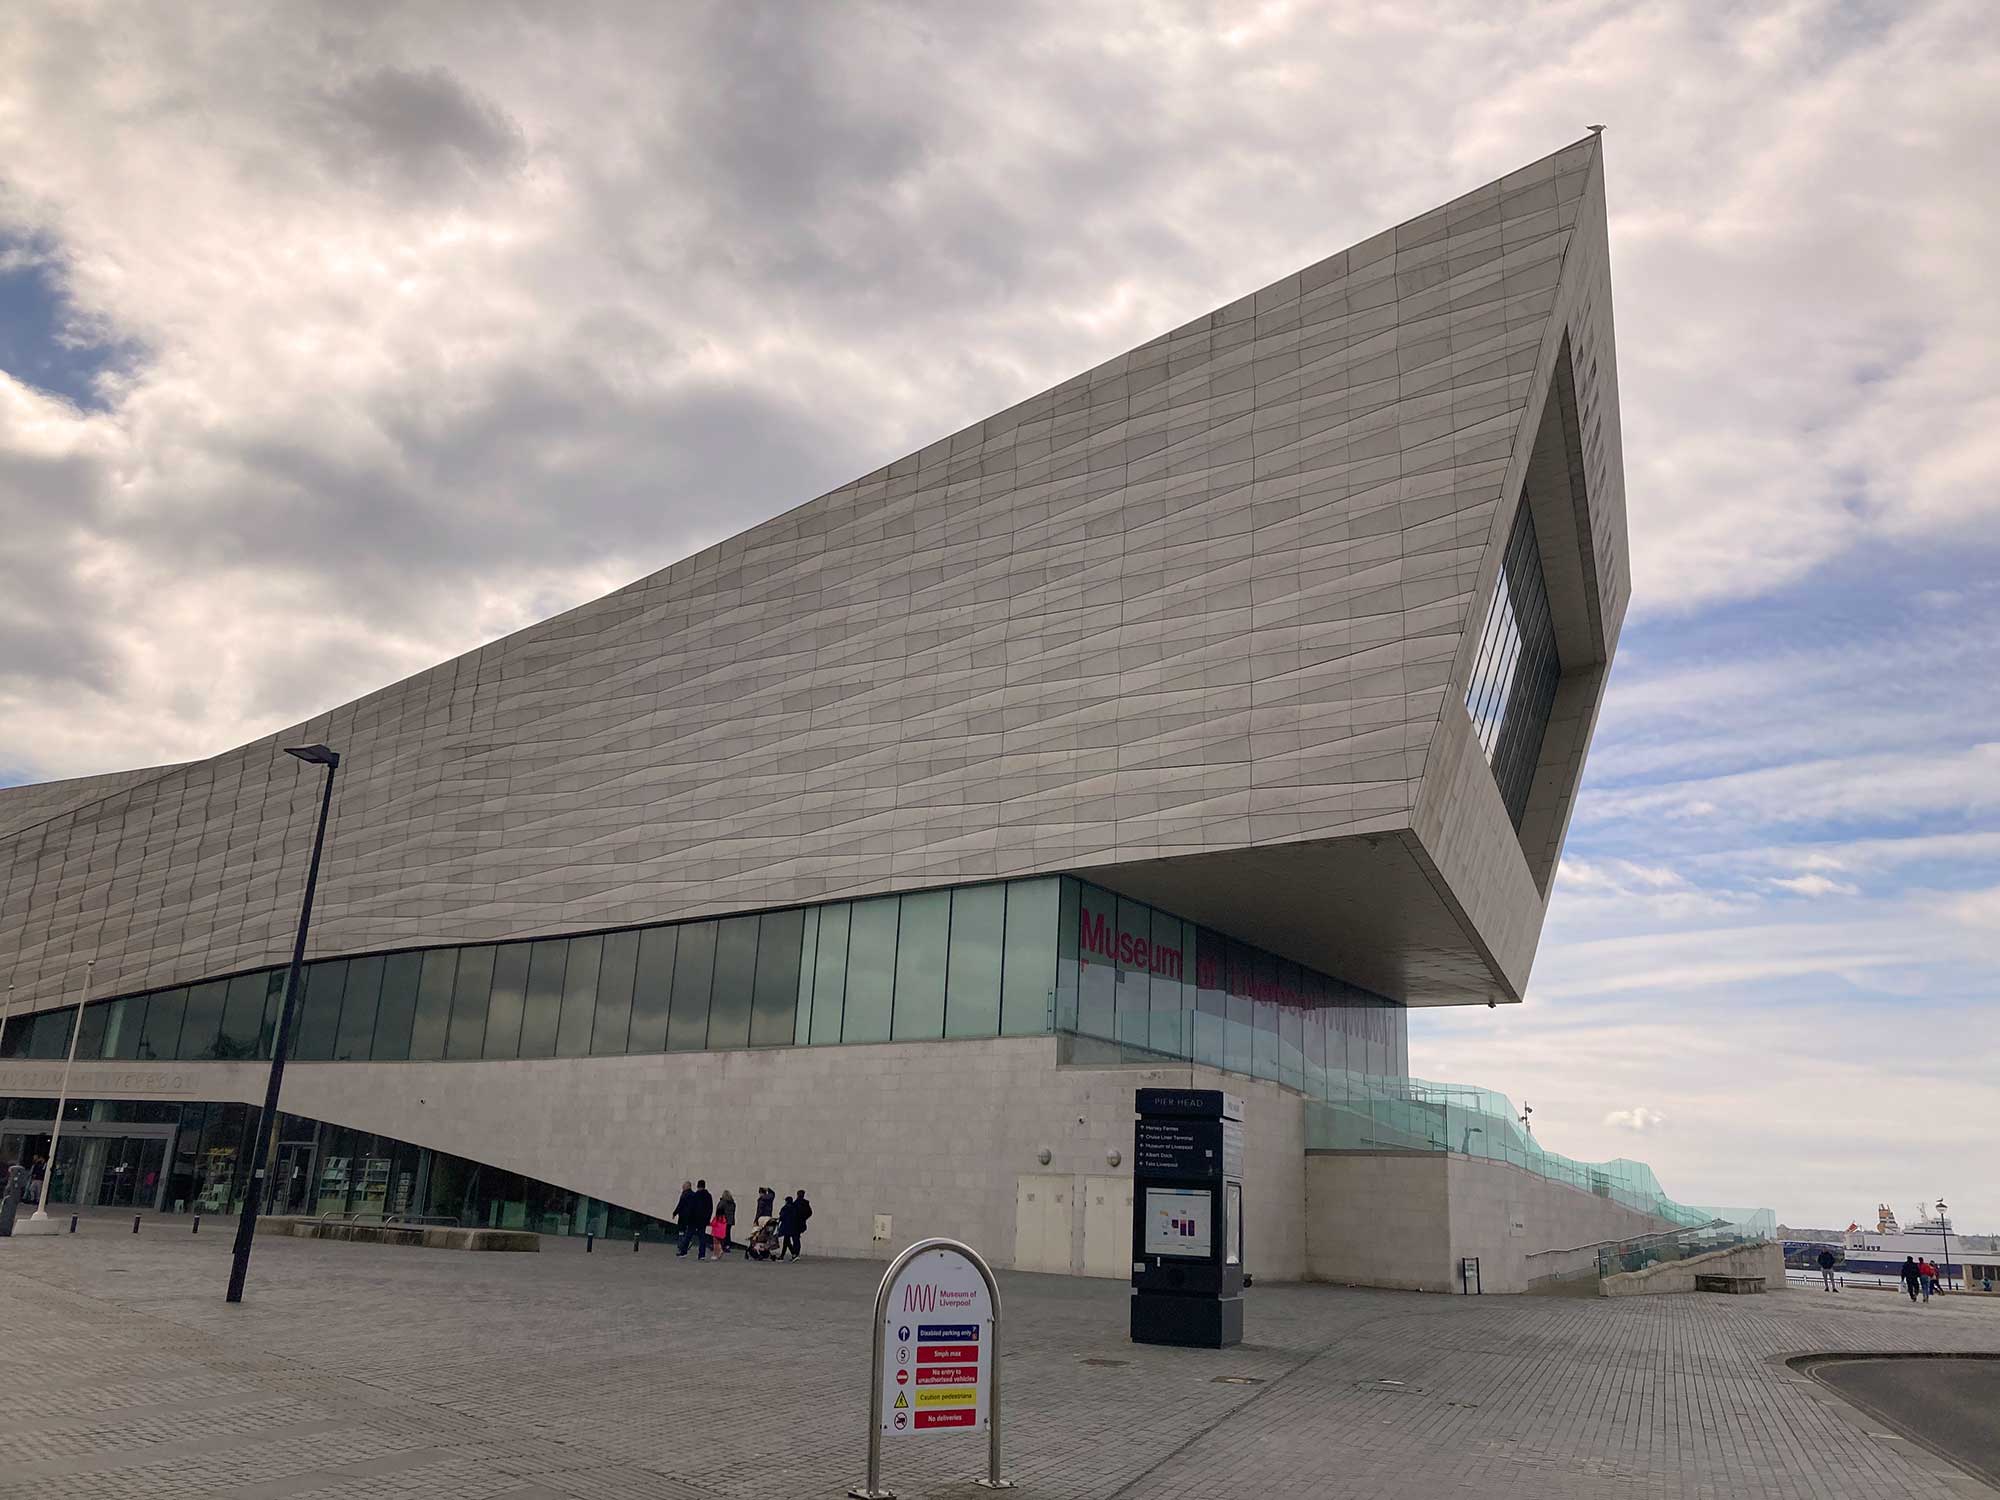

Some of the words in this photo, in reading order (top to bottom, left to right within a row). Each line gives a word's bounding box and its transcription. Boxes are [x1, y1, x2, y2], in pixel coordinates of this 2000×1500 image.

[1081, 908, 1183, 979] Museum
[1154, 1097, 1174, 1105] PIER
[1177, 1098, 1203, 1108] HEAD
[940, 1290, 969, 1298] Museum
[969, 1290, 977, 1298] of
[939, 1299, 971, 1308] Liverpool
[920, 1329, 942, 1337] Disabled
[942, 1329, 960, 1338] parking
[961, 1329, 972, 1337] only
[900, 1349, 906, 1359] 5
[934, 1350, 949, 1358] 5mph
[940, 1369, 955, 1377] entry
[941, 1393, 972, 1401] pedestrians
[936, 1414, 962, 1422] deliveries
